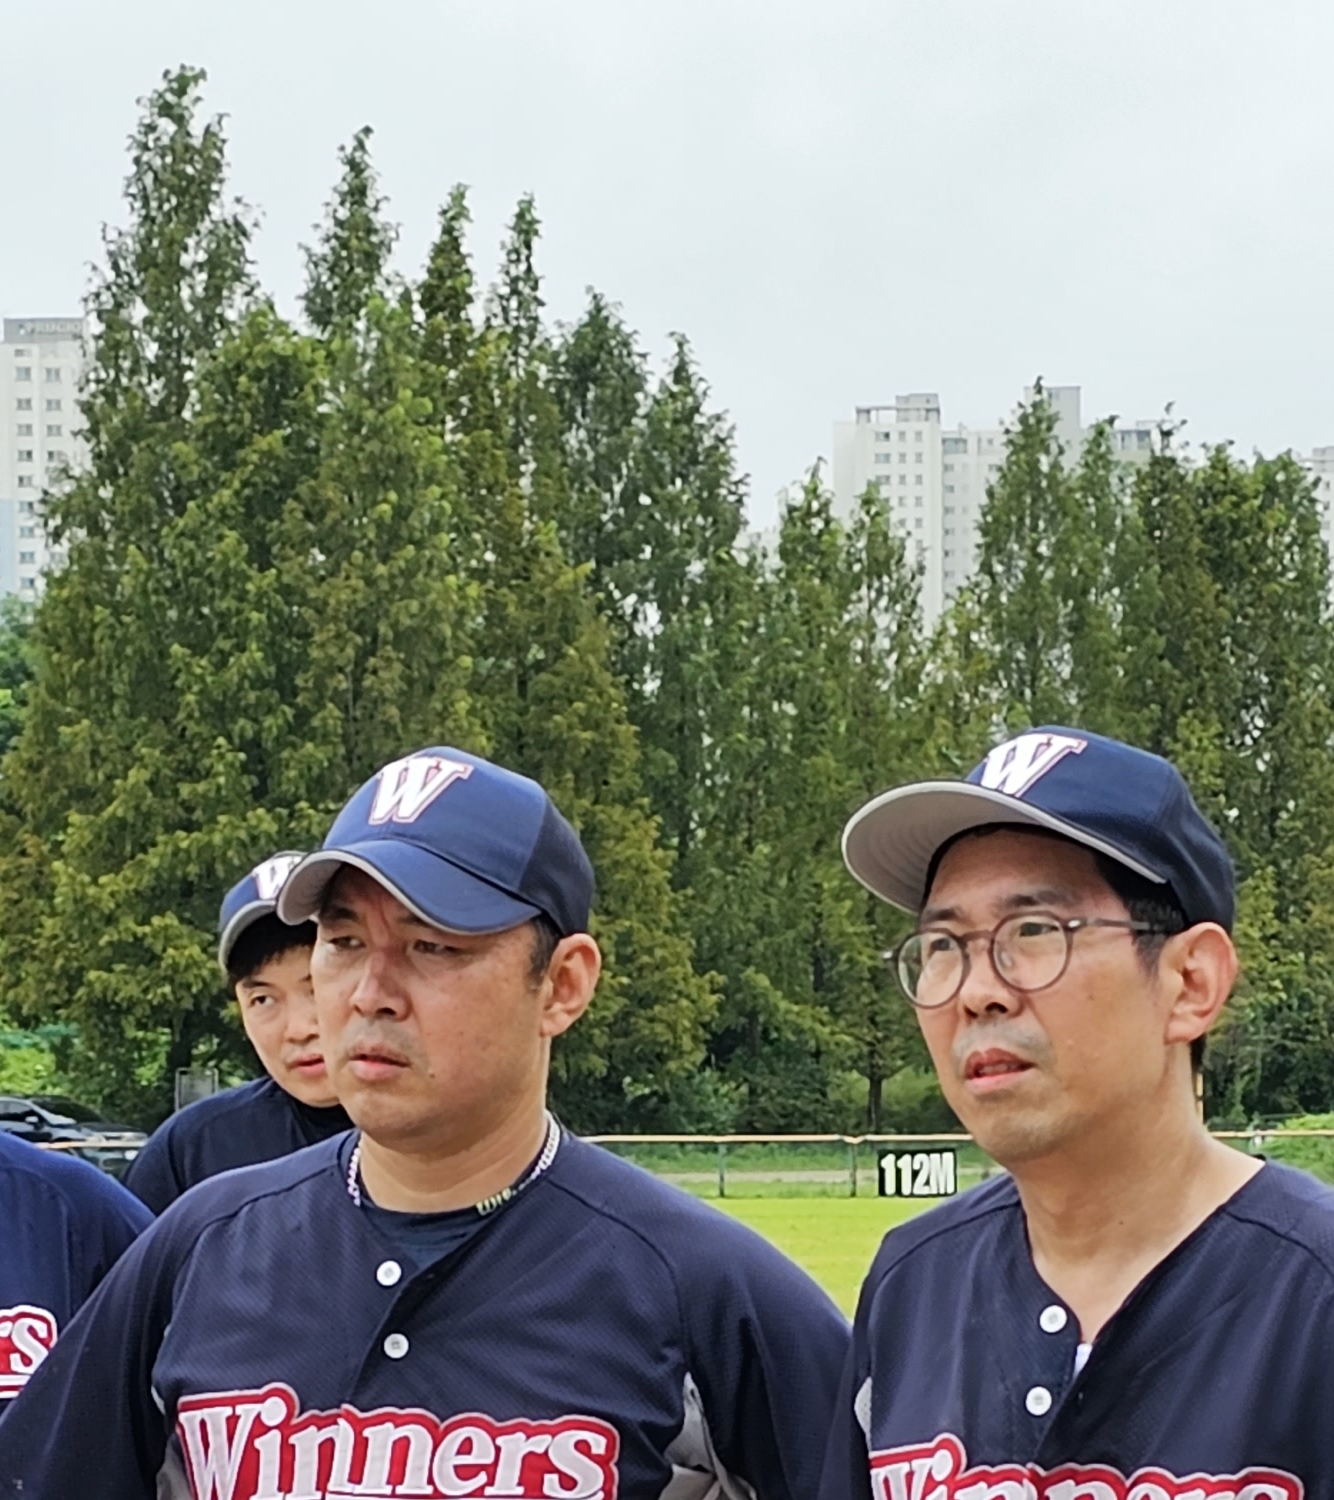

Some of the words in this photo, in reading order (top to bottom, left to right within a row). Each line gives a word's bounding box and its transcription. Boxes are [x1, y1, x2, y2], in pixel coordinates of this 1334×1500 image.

[369, 754, 473, 825] W
[979, 732, 1087, 797] W
[879, 1151, 956, 1196] 112M
